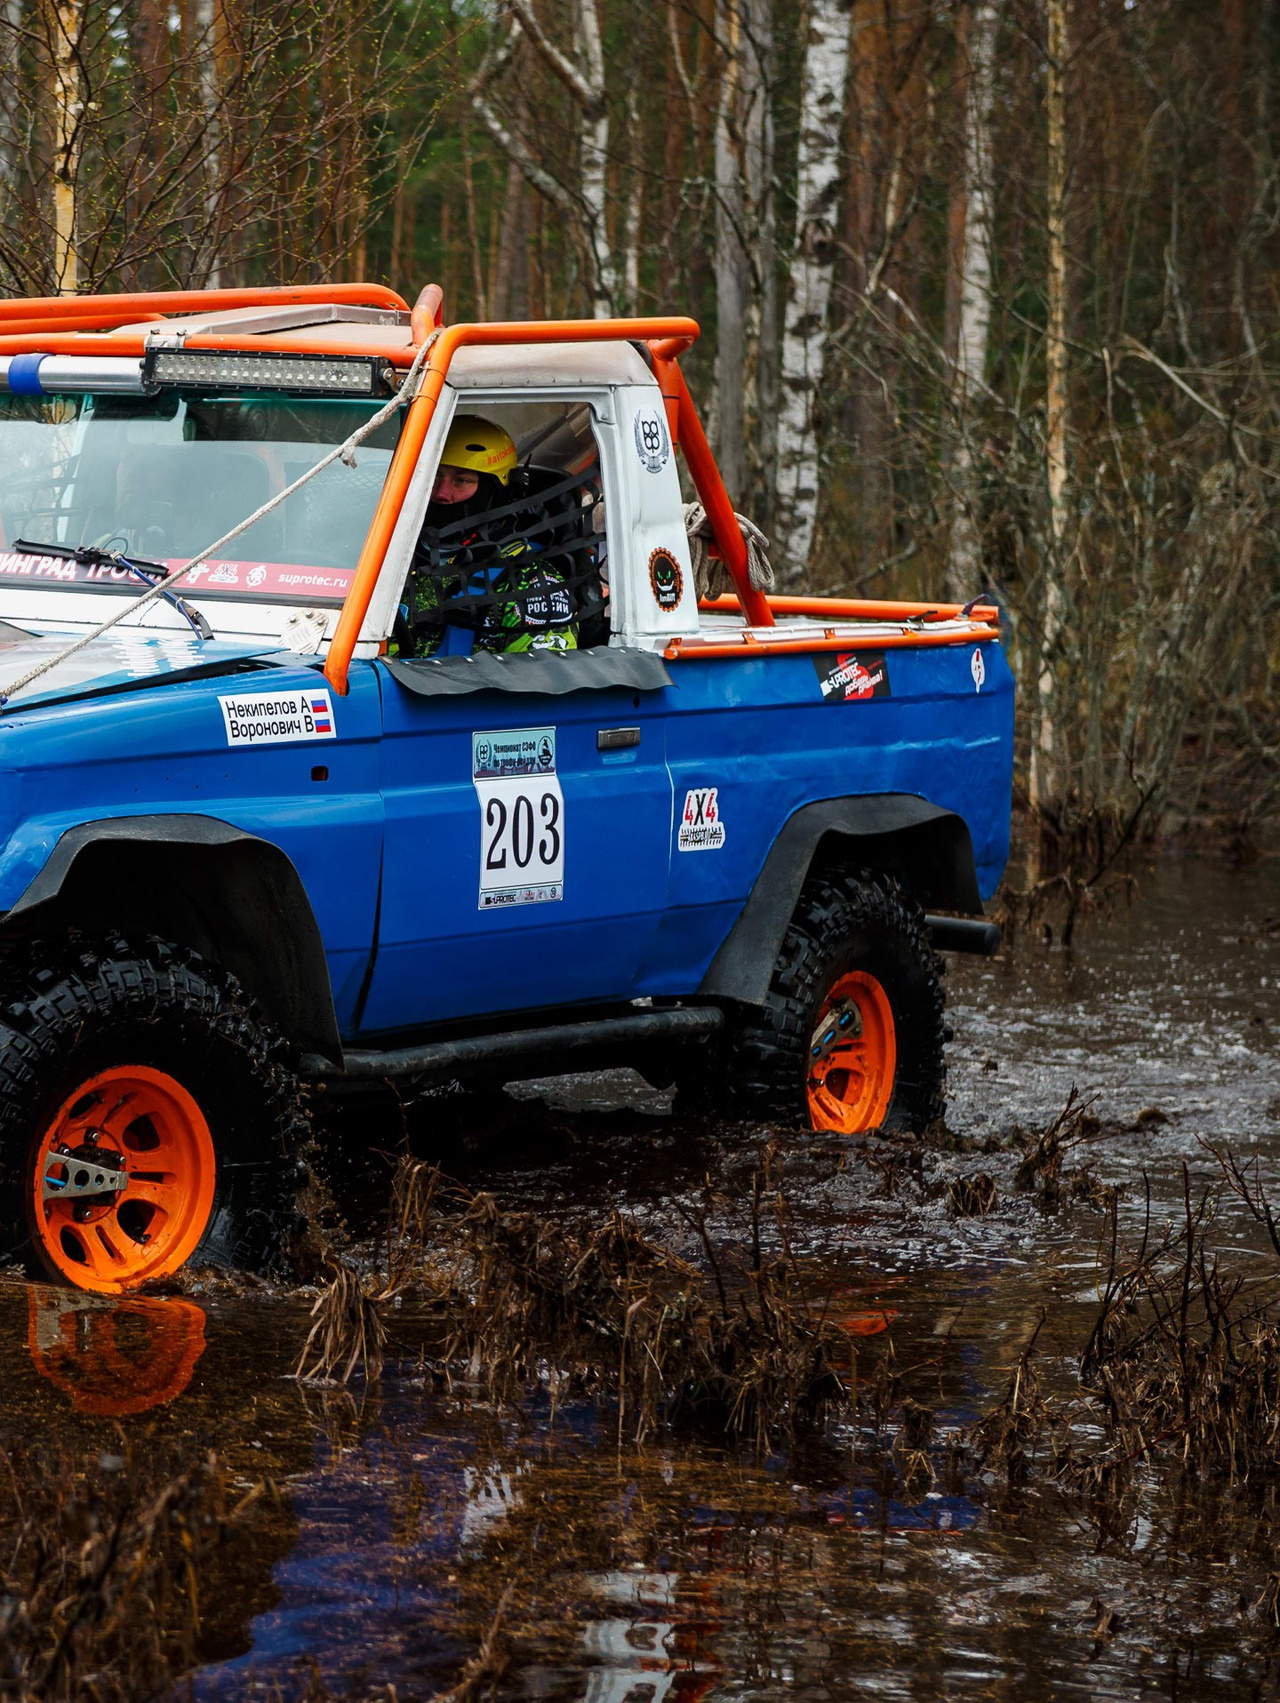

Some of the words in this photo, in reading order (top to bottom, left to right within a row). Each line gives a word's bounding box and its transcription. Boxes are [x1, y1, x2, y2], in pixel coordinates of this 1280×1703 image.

[278, 573, 348, 588] suprotec.ru
[225, 700, 297, 718] Некипелов
[301, 696, 311, 714] А
[230, 719, 302, 741] Воронович
[304, 715, 314, 733] В
[684, 793, 716, 826] 4X4
[486, 792, 560, 870] 203
